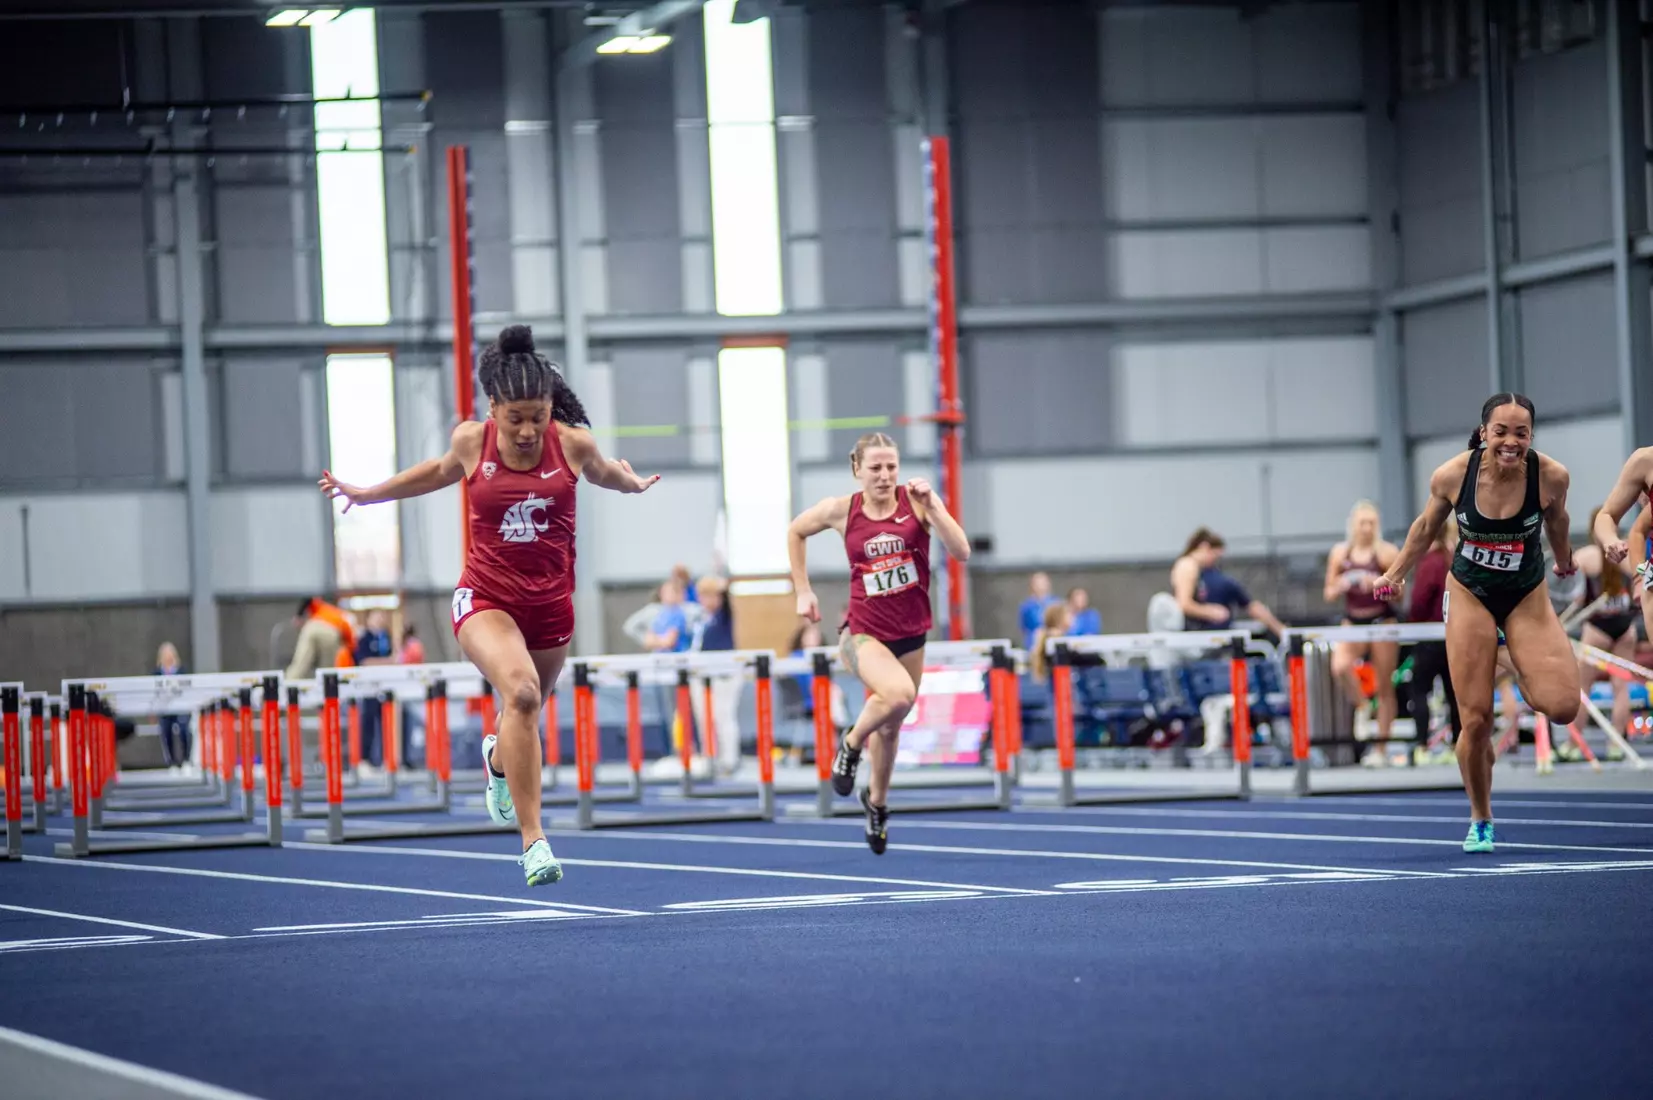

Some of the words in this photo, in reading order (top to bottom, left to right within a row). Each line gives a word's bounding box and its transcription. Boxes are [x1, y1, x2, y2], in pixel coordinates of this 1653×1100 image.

[866, 540, 904, 557] CWU
[1471, 546, 1513, 569] 615
[873, 565, 909, 592] 176
